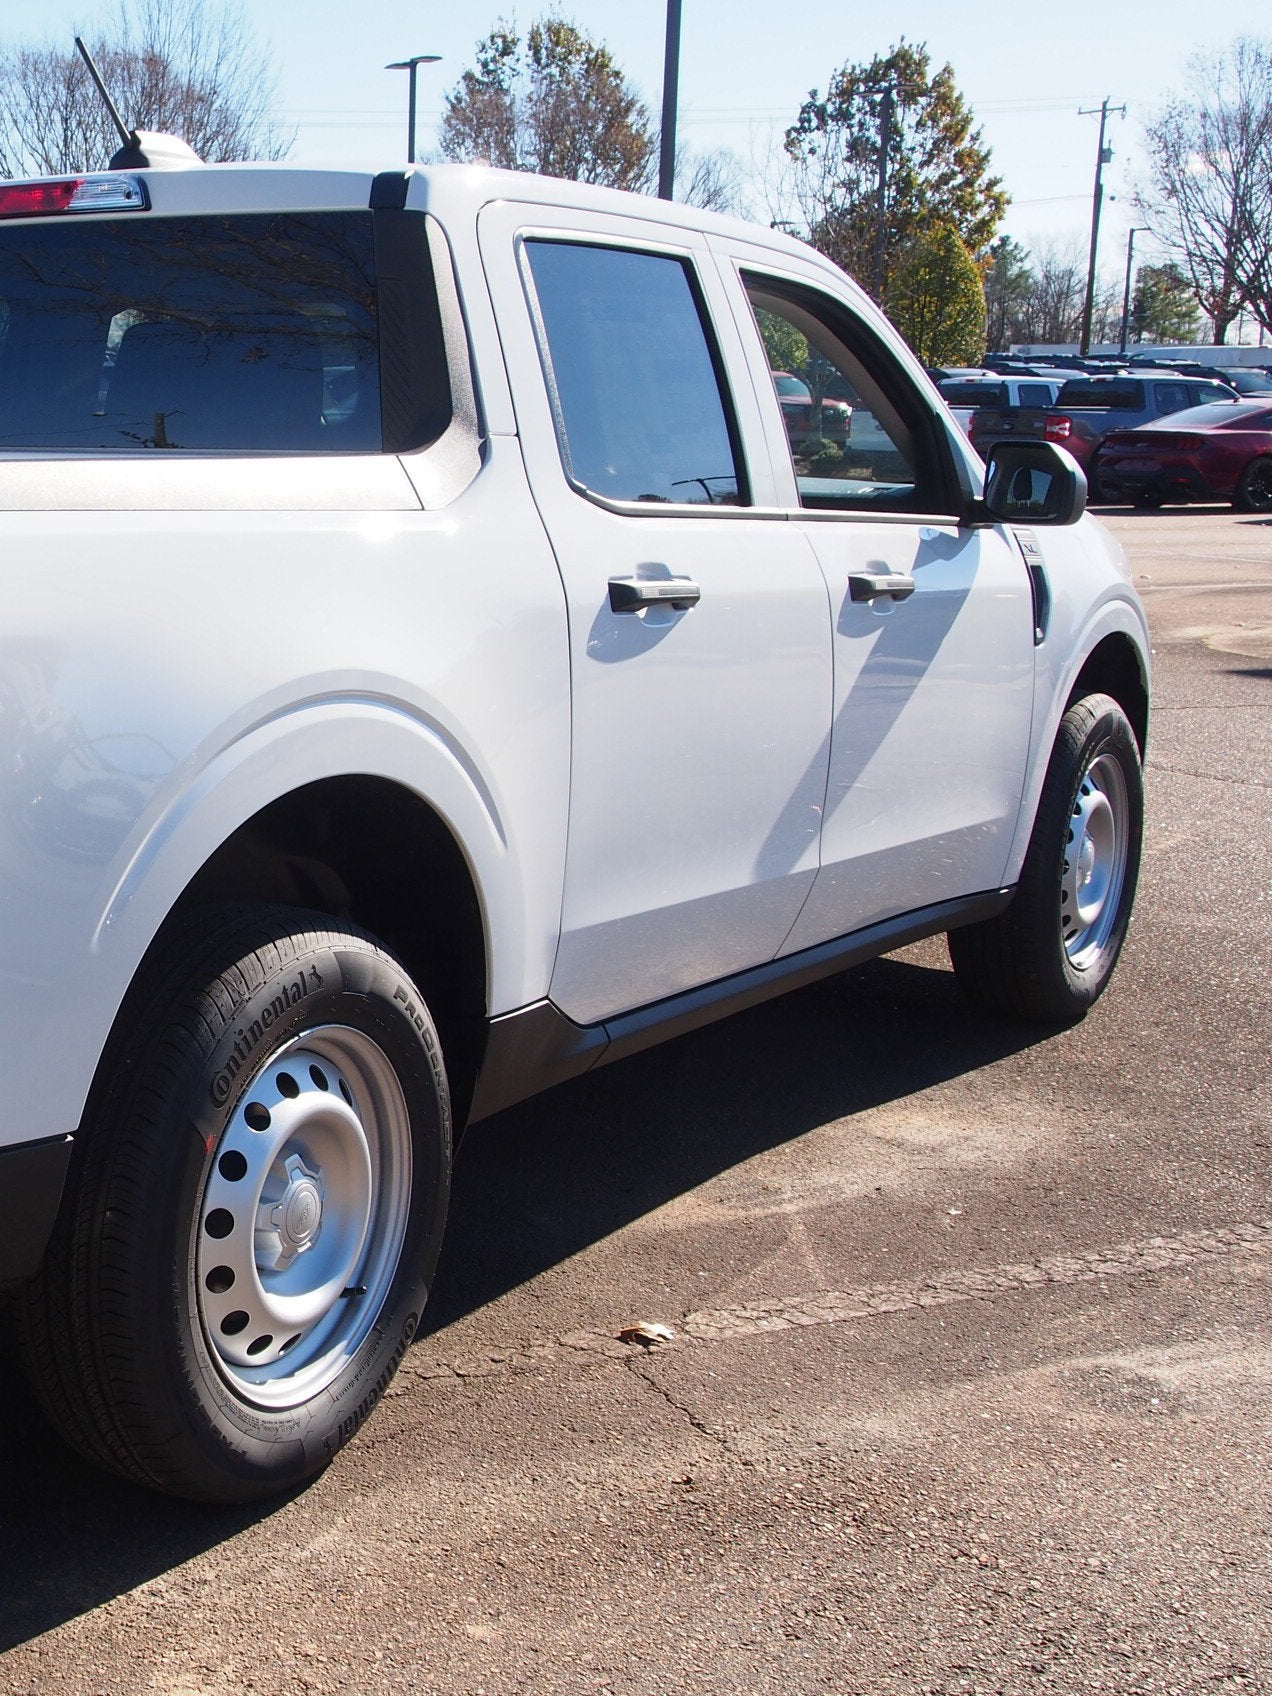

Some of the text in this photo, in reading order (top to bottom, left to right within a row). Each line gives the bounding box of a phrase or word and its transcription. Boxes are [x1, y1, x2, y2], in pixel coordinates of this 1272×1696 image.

[1023, 543, 1038, 554] XL
[211, 967, 309, 1110] Continental
[336, 1311, 419, 1443] Continental
